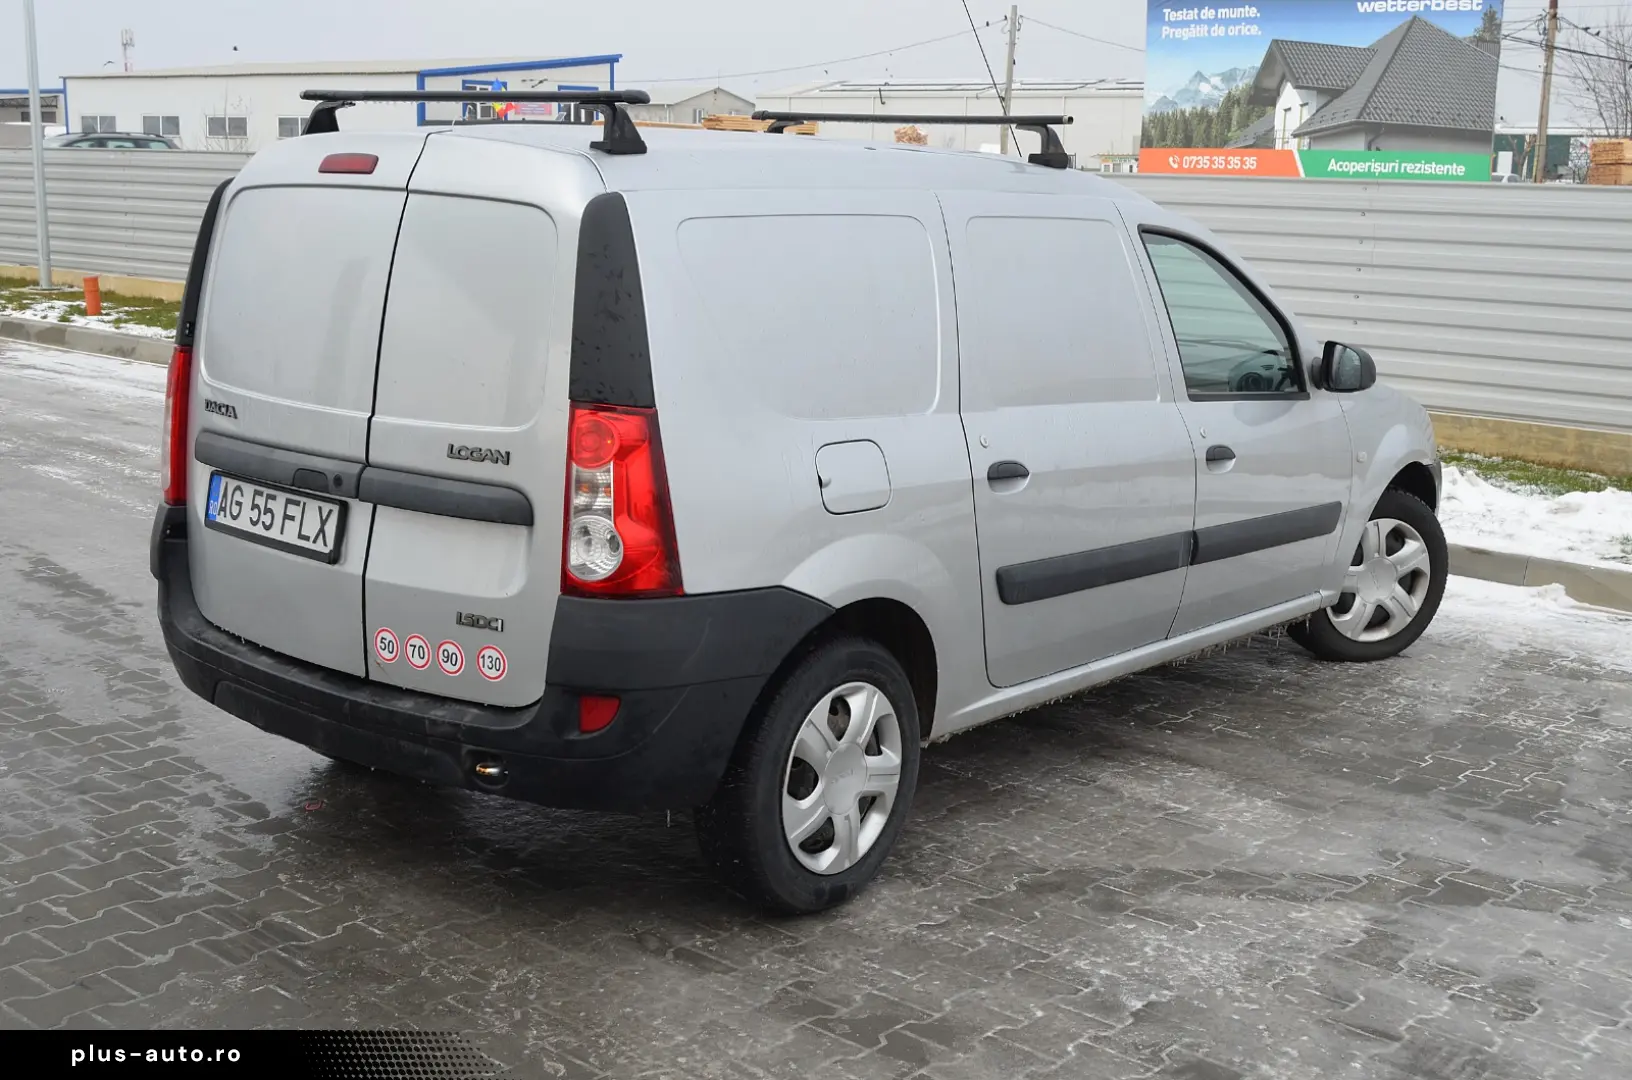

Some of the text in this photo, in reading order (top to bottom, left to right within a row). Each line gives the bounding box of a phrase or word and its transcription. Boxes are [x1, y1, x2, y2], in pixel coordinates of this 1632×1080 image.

[1162, 5, 1261, 22] Testat de munte.
[1356, 0, 1483, 12] wetterbest
[1161, 22, 1262, 41] Pregătit de orice.
[1182, 156, 1257, 170] 0735 35 35 35
[1327, 158, 1466, 176] Acoperișuri rezistente
[204, 399, 238, 420] DACIA
[446, 443, 511, 466] LOGAN
[217, 481, 334, 547] AG 55 FLX
[379, 636, 395, 655] 50
[409, 644, 426, 660] 70
[441, 648, 459, 667] 90
[480, 653, 502, 672] 130
